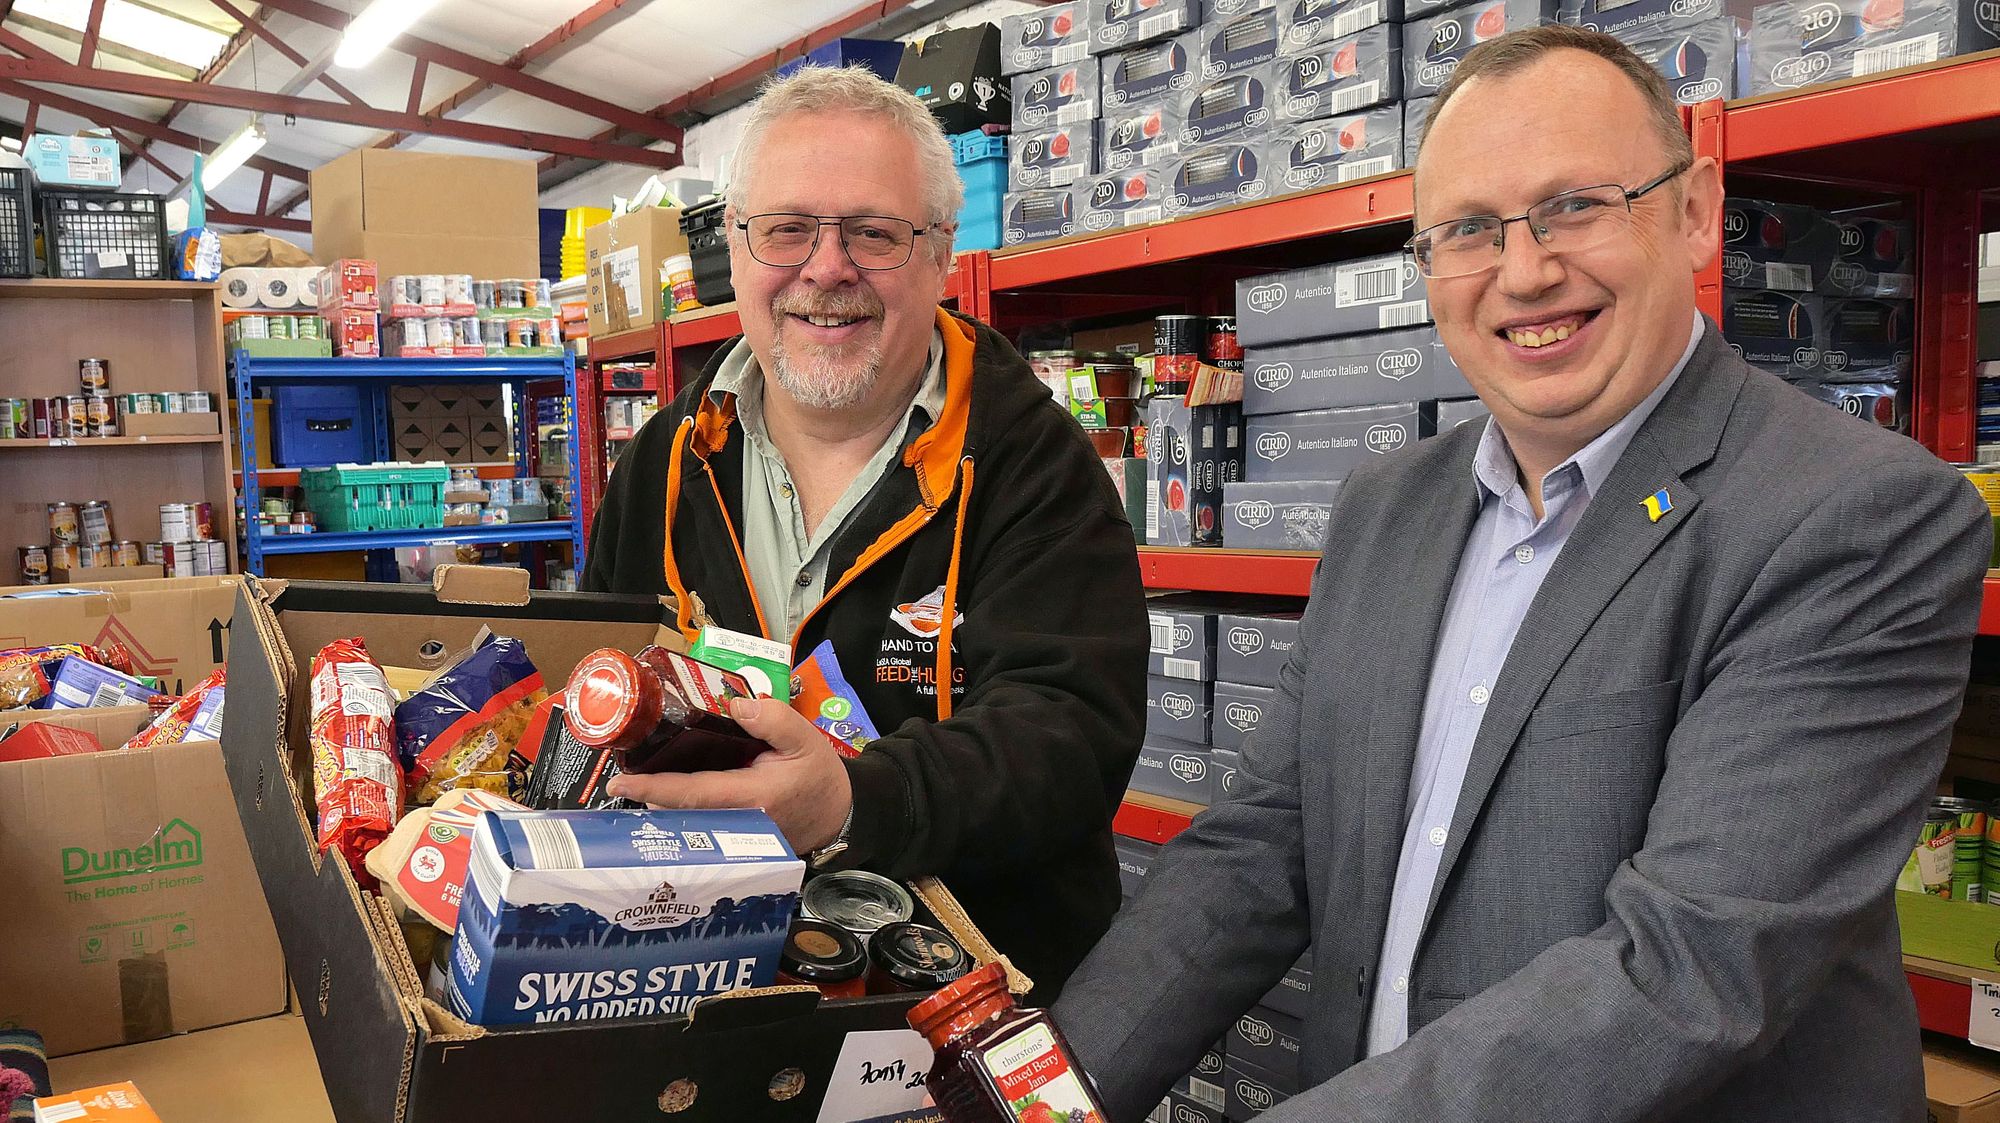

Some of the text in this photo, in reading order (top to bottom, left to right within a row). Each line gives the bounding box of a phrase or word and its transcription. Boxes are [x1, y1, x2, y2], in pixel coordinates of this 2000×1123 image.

[1292, 22, 1320, 37] CIRIO
[1603, 11, 1666, 34] Autentico Italiano
[1101, 25, 1125, 39] CIRIO
[1205, 53, 1273, 75] CIRIO Autentico Italiano
[1777, 56, 1826, 80] CIRIO
[1105, 92, 1125, 103] CIRIO
[1171, 74, 1192, 86] CIRIO
[1682, 82, 1718, 97] CIRIO
[1288, 95, 1316, 111] CIRIO
[1181, 111, 1267, 143] CIRIO Autentico Italiano CIRIO
[1288, 169, 1321, 182] CIRIO
[1165, 197, 1187, 209] CIRIO
[1191, 193, 1215, 204] Autentico
[1240, 182, 1263, 194] CIRIO
[1086, 213, 1111, 226] CIRIO
[1251, 287, 1283, 306] CIRIO
[1294, 285, 1332, 301] Autentico
[1796, 350, 1818, 361] CIRIO
[1824, 354, 1845, 365] CIRIO
[1258, 353, 1418, 383] CIRIO Autentico Italiano CIRIO
[1258, 428, 1403, 451] CIRIO Autentico Italiano CIRIO
[1239, 504, 1271, 520] CIRIO
[1281, 509, 1317, 520] Autentico
[881, 639, 913, 652] HAND
[915, 641, 934, 652] TO
[1231, 632, 1260, 646] CIRIO
[890, 657, 912, 666] Global
[876, 666, 911, 683] FEED
[918, 667, 965, 683] HUG
[1164, 698, 1191, 711] CIRIO
[1229, 709, 1259, 723] CIRIO
[1173, 760, 1202, 775] CIRIO
[631, 839, 682, 848] SWISS STYLE
[62, 835, 195, 876] Dunelm
[64, 873, 205, 903] The Home of Homes
[441, 893, 447, 901] 6
[614, 903, 701, 922] CROWNFIELD
[514, 957, 757, 1011] SWISS STYLE
[535, 1005, 572, 1023] NO
[574, 996, 655, 1020] ADDED
[1240, 1018, 1270, 1040] CIRIO
[1002, 1041, 1043, 1068] thurstons
[1002, 1053, 1059, 1089] Mixed Berry
[1027, 1074, 1048, 1090] Jam
[1239, 1083, 1270, 1105] CIRIO
